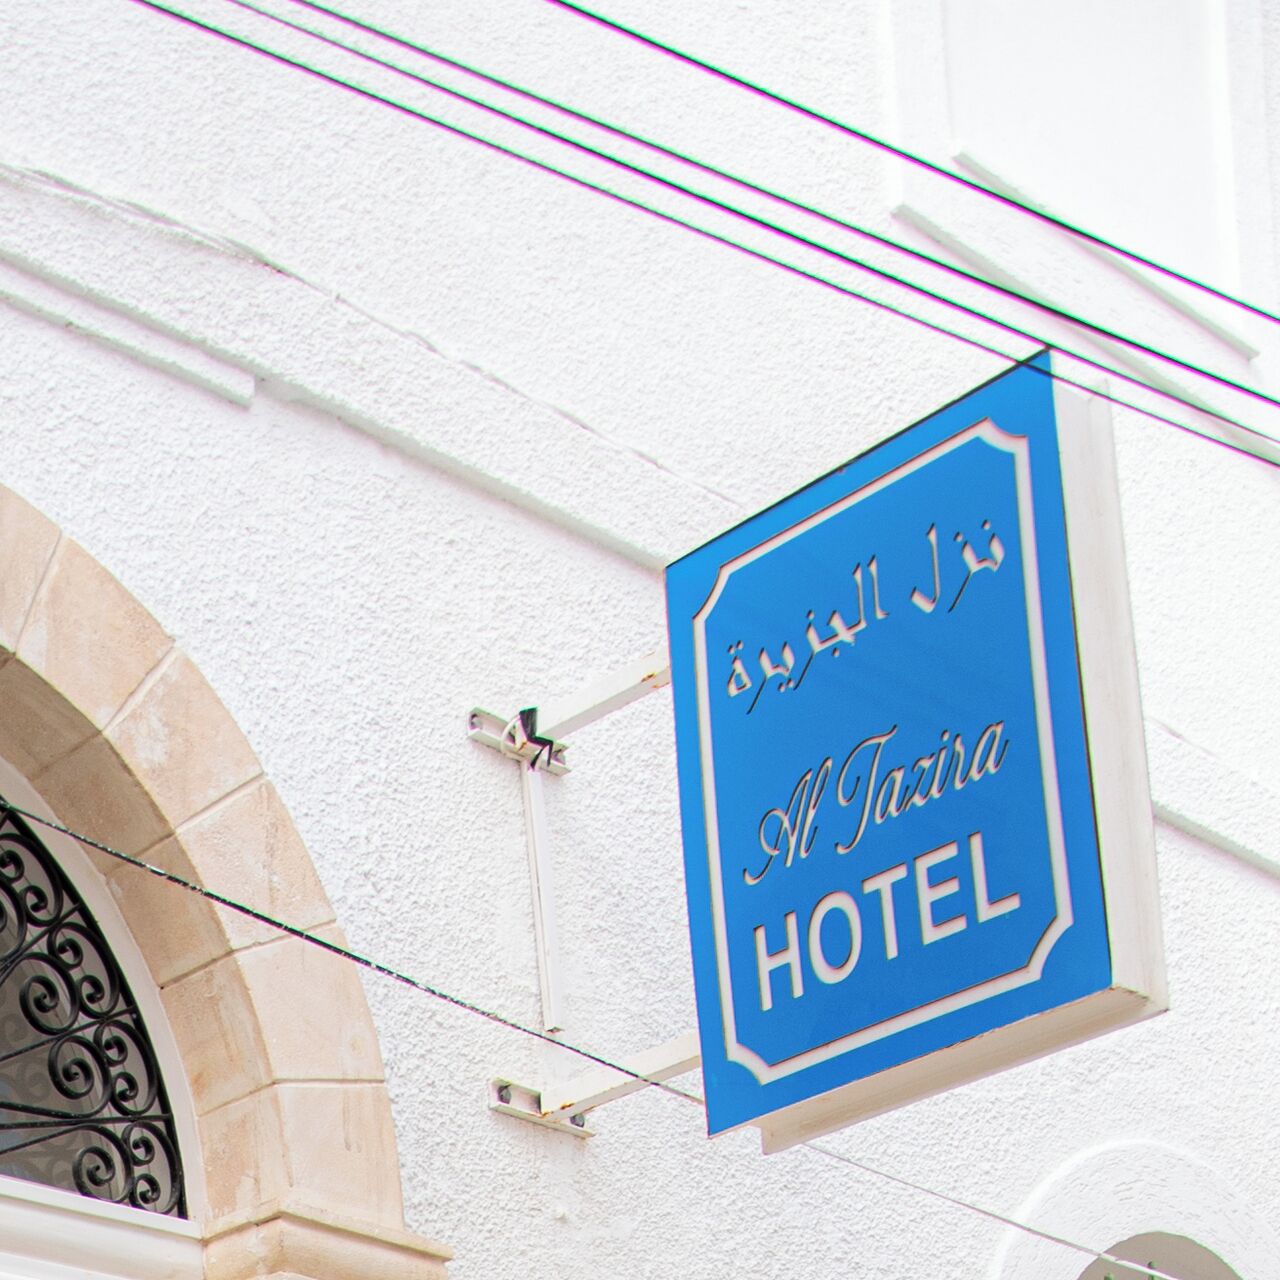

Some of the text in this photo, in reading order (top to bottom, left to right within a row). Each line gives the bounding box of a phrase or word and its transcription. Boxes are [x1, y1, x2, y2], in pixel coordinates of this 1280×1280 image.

[727, 519, 1005, 714] نزل الجزيرة
[743, 756, 832, 885] Al
[753, 831, 1021, 1012] HOTEL
